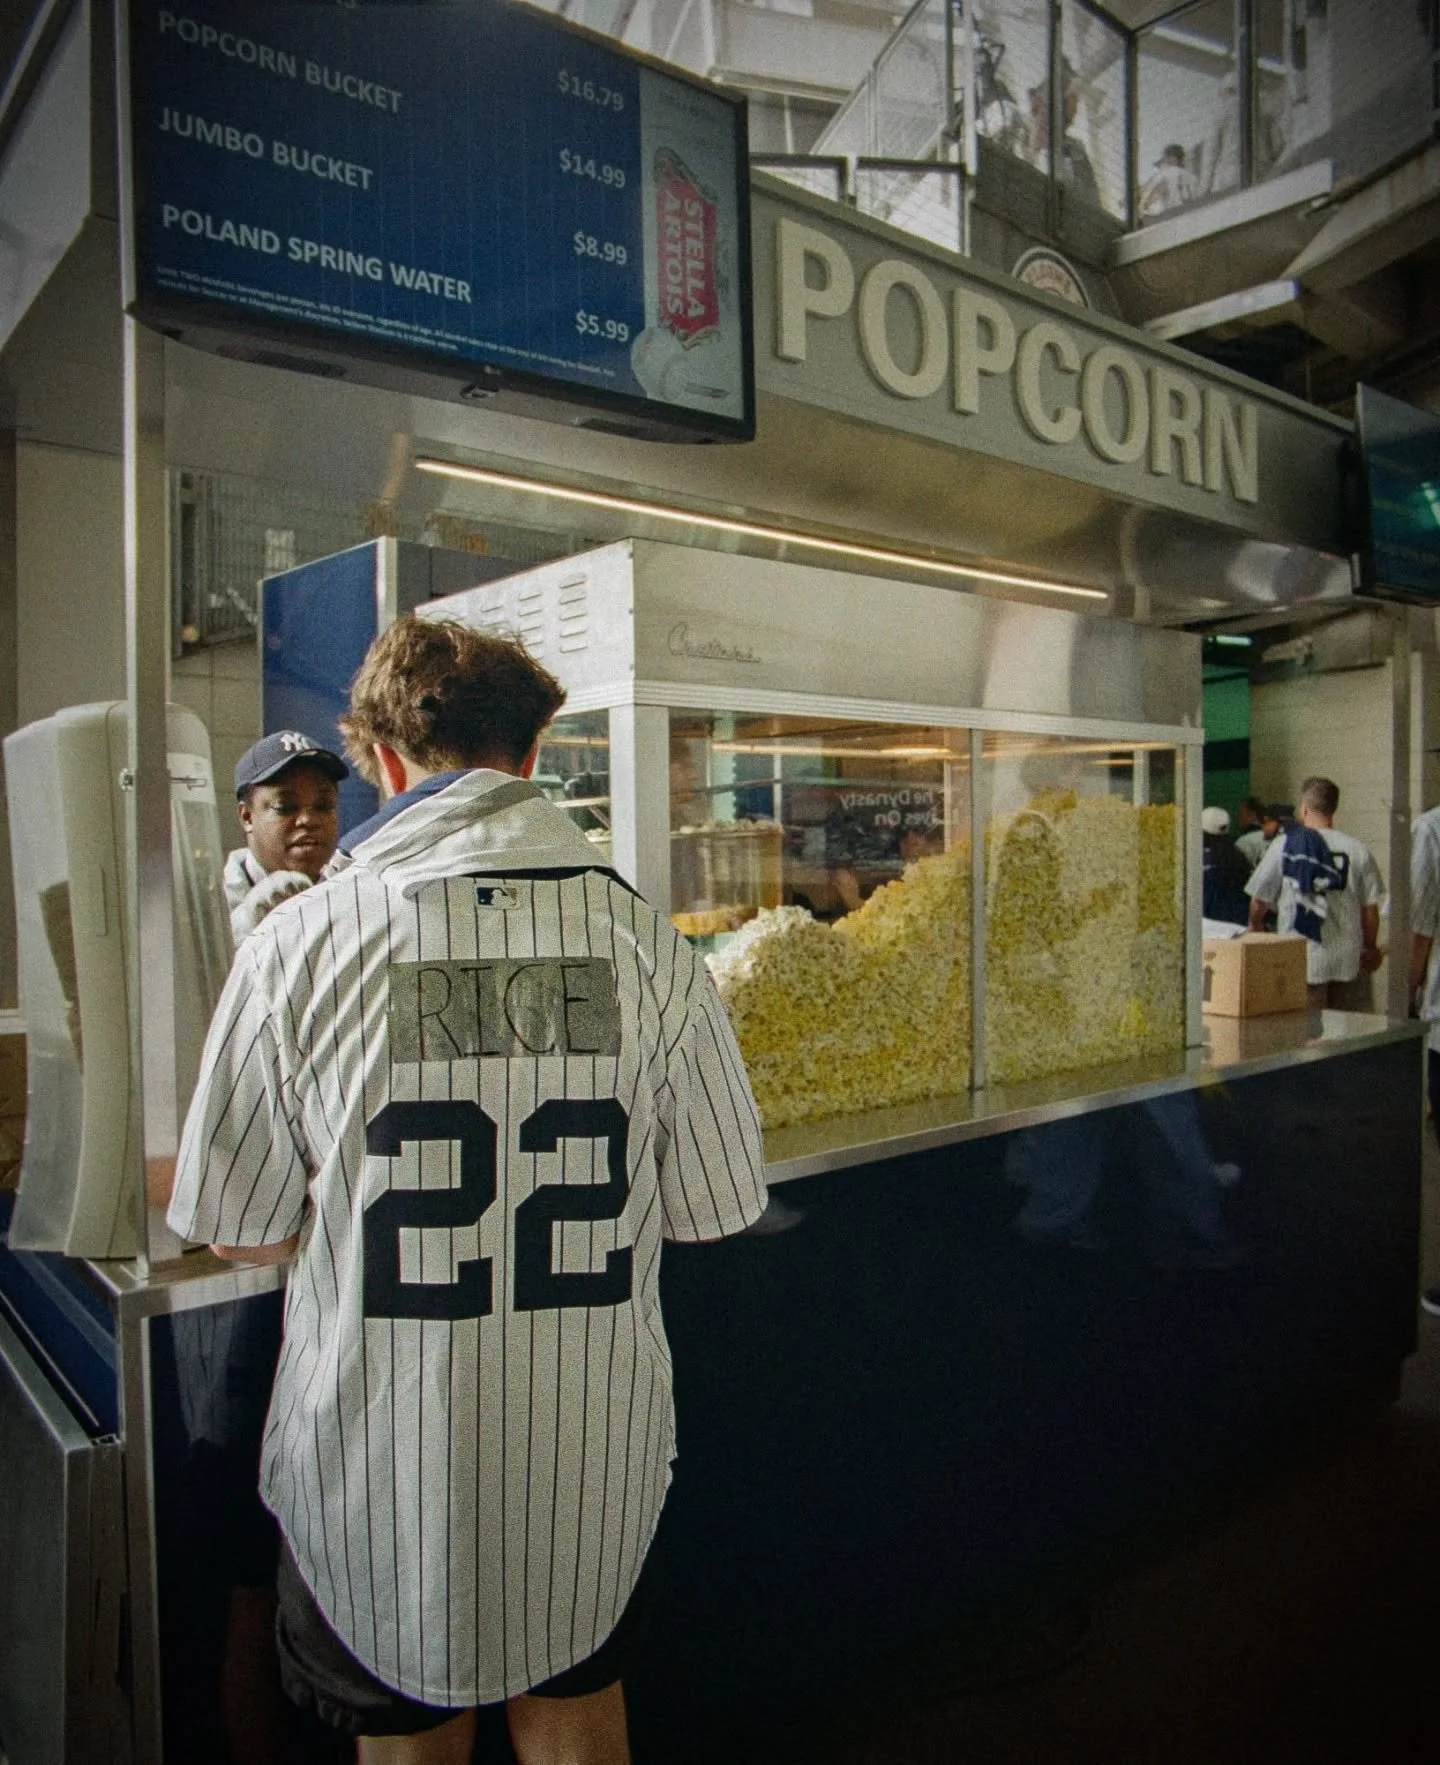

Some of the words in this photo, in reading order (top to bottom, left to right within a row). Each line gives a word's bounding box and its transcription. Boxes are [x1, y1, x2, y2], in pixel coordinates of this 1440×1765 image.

[158, 10, 298, 80] POPCORN
[304, 60, 403, 114] BUCKET
[558, 70, 625, 112] $16.79
[159, 106, 265, 159] JUMBO
[272, 140, 374, 190] BUCKET
[559, 147, 627, 189] $14.99
[161, 203, 281, 255] POLAND
[287, 236, 384, 281] SPRING
[389, 261, 473, 304] WATER
[573, 231, 628, 266] $8.99
[665, 189, 684, 315] ARTOIS
[684, 198, 706, 317] STELLA
[575, 309, 629, 343] $5.99
[774, 216, 1258, 503] POPCORN
[415, 962, 600, 1060] RICE
[363, 1097, 634, 1320] 22
